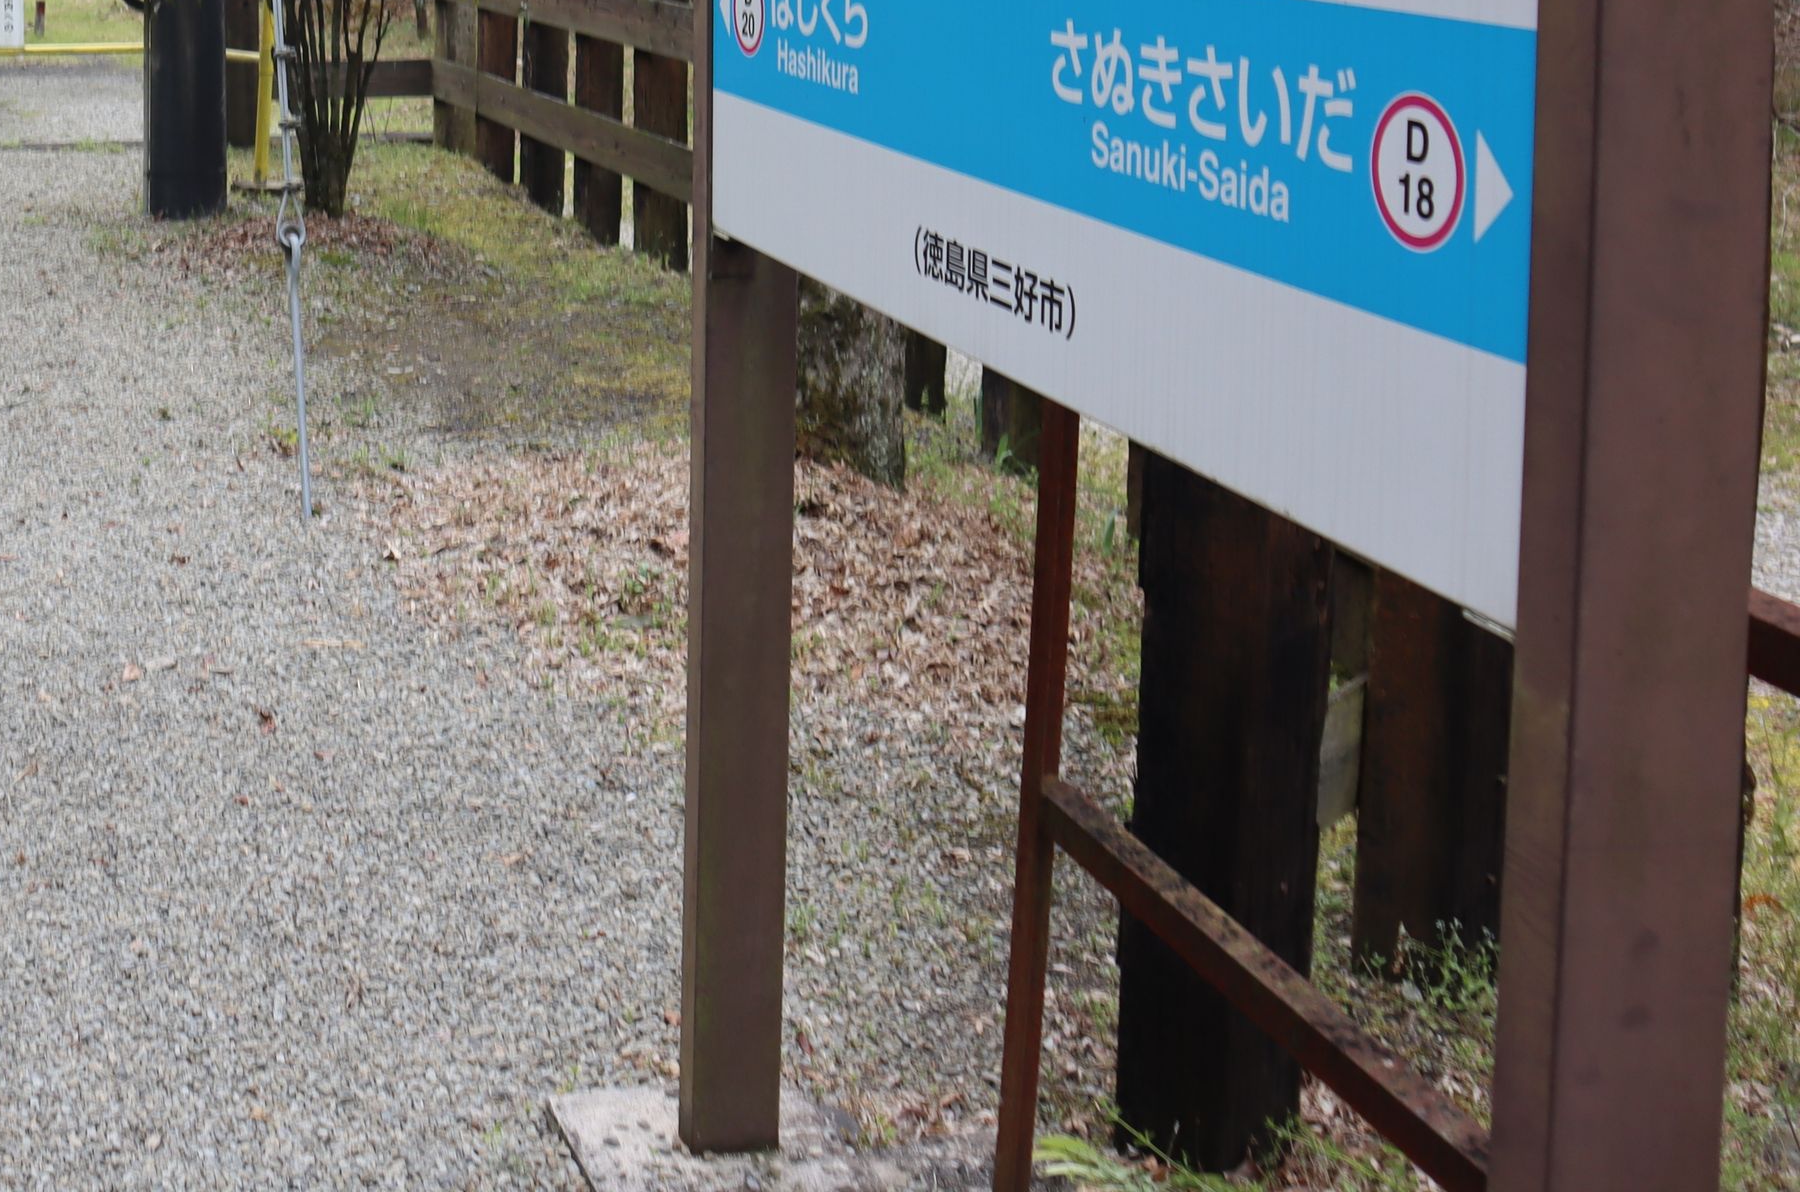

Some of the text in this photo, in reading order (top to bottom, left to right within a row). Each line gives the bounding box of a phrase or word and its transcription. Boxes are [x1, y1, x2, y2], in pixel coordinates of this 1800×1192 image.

[742, 12, 755, 39] 20
[777, 37, 859, 95] Hashikura
[1050, 18, 1356, 173] さぬきさいだ
[1406, 119, 1430, 165] D
[1091, 121, 1289, 224] Sanuki-Saida
[1398, 173, 1436, 221] 18
[914, 225, 1076, 340] (徳島県三好市)
